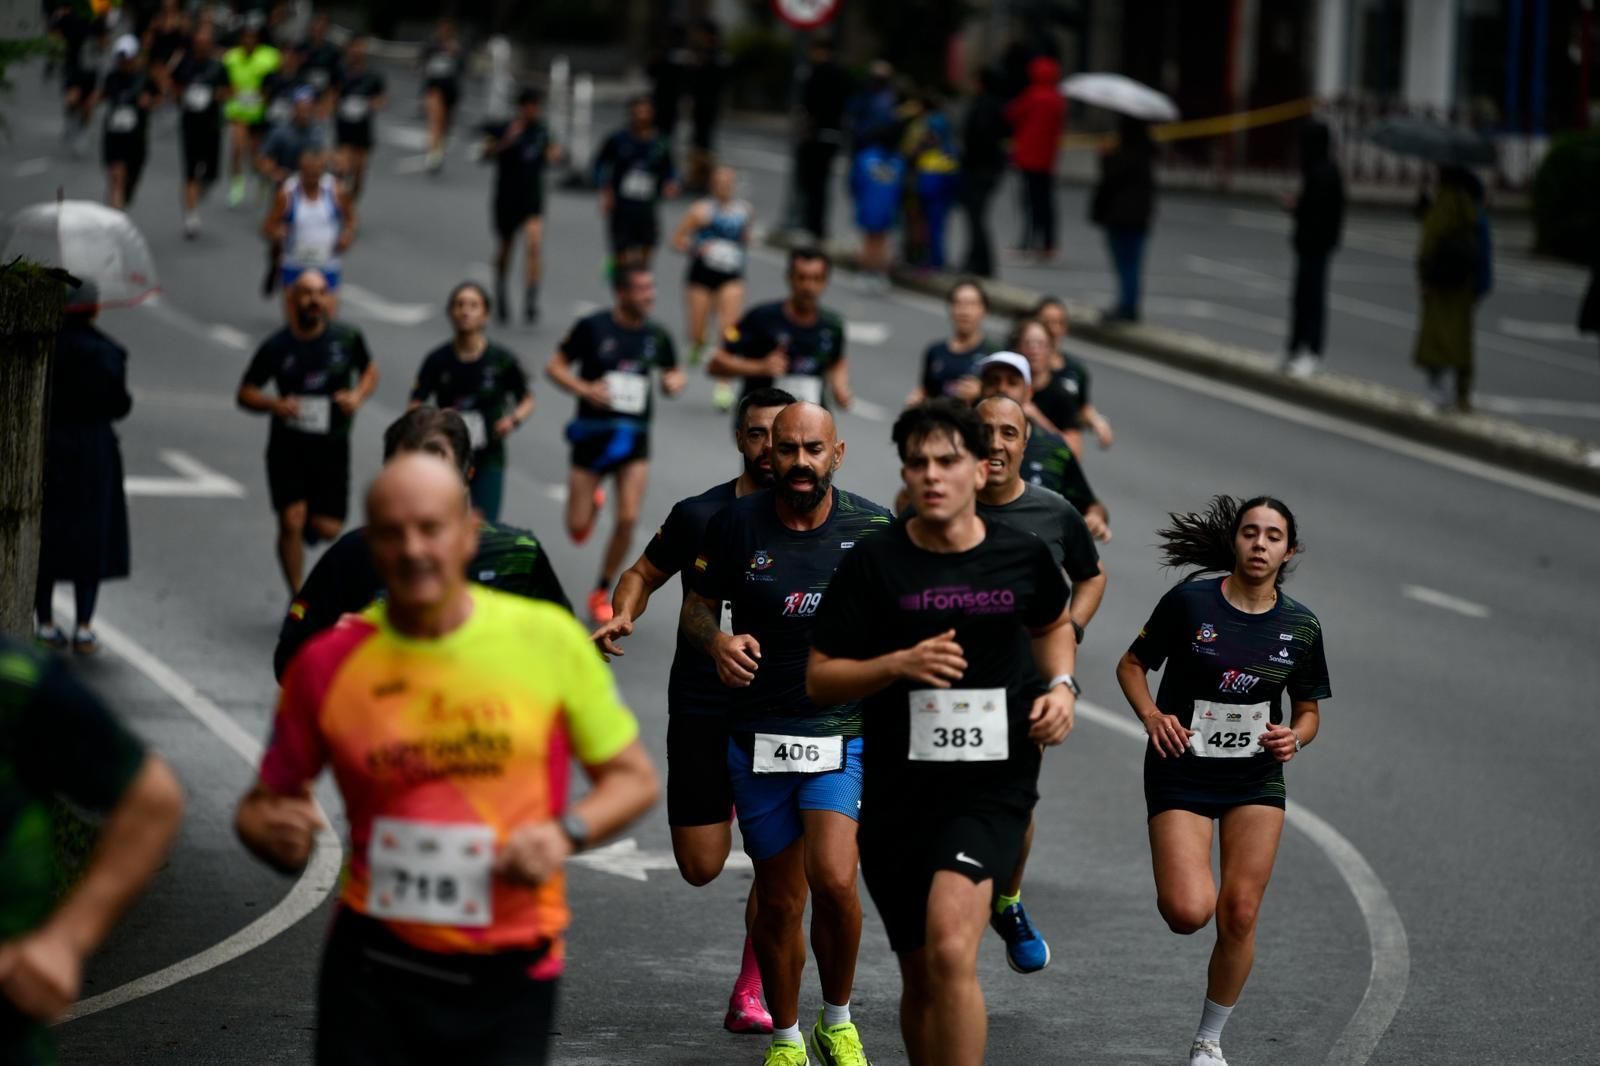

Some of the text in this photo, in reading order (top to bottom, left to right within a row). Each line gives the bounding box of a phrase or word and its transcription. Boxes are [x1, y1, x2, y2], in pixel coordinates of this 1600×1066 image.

[1268, 655, 1295, 665] Santander
[933, 727, 984, 748] 383
[1208, 731, 1251, 748] 425
[774, 743, 820, 762] 406
